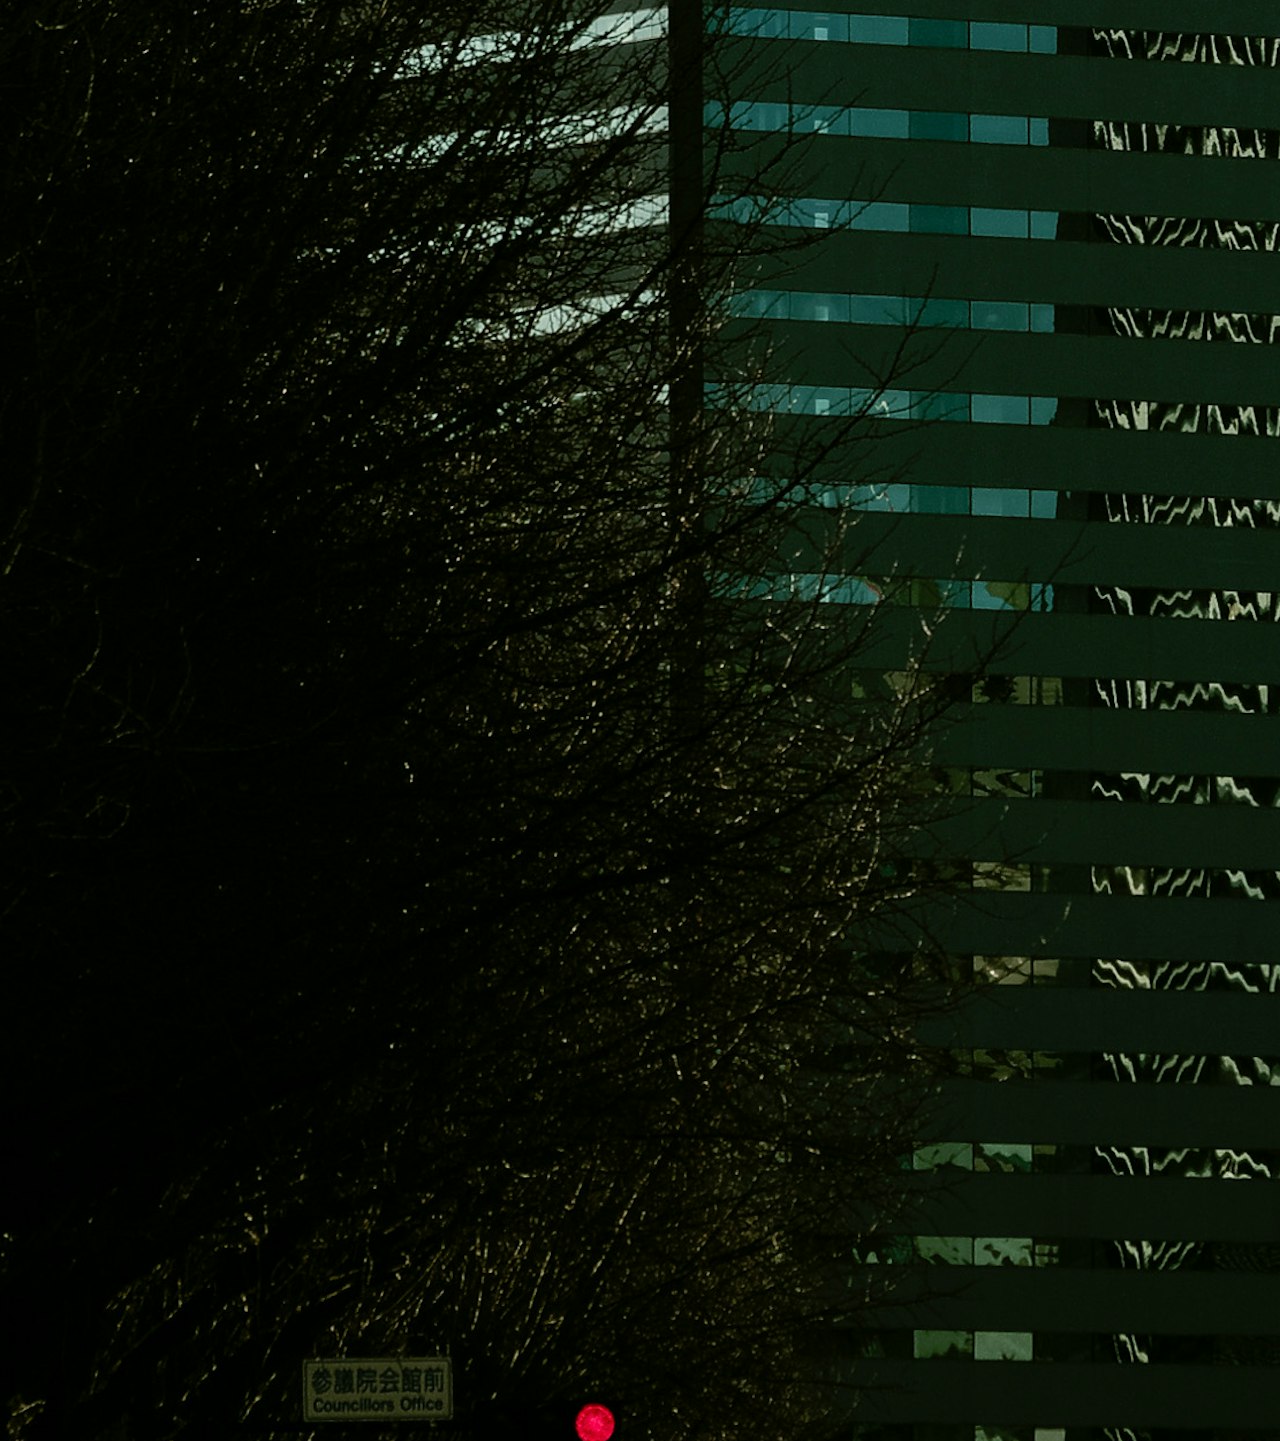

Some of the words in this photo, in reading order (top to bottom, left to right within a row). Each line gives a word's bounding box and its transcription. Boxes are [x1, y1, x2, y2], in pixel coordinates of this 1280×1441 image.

[312, 1367, 444, 1394] 参議院会館前
[313, 1397, 395, 1413] Councillors
[400, 1396, 444, 1411] Office
